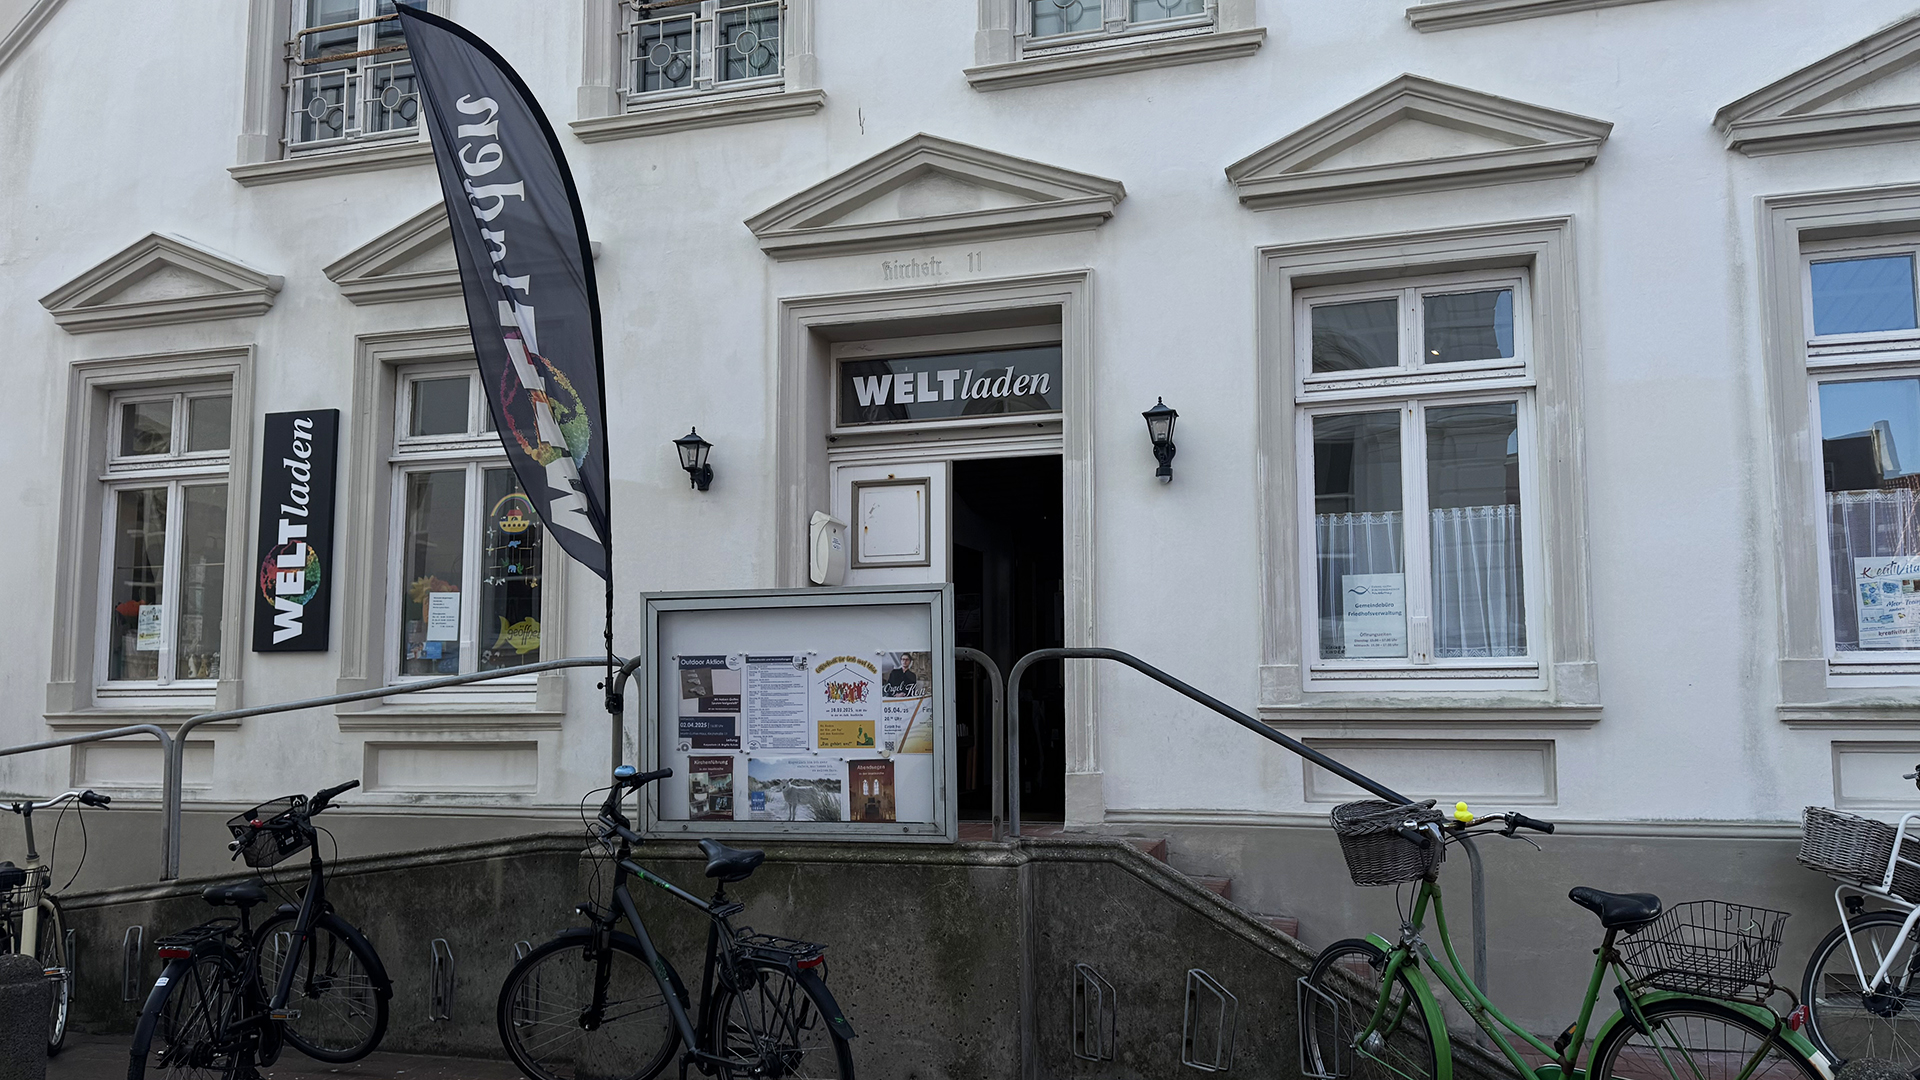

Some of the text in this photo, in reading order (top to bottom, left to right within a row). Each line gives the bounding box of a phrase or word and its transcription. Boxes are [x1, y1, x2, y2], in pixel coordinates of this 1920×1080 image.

[967, 251, 983, 273] 11
[853, 366, 1051, 407] WELTladen
[272, 417, 314, 645] WELTladen
[883, 680, 904, 696] Orgel
